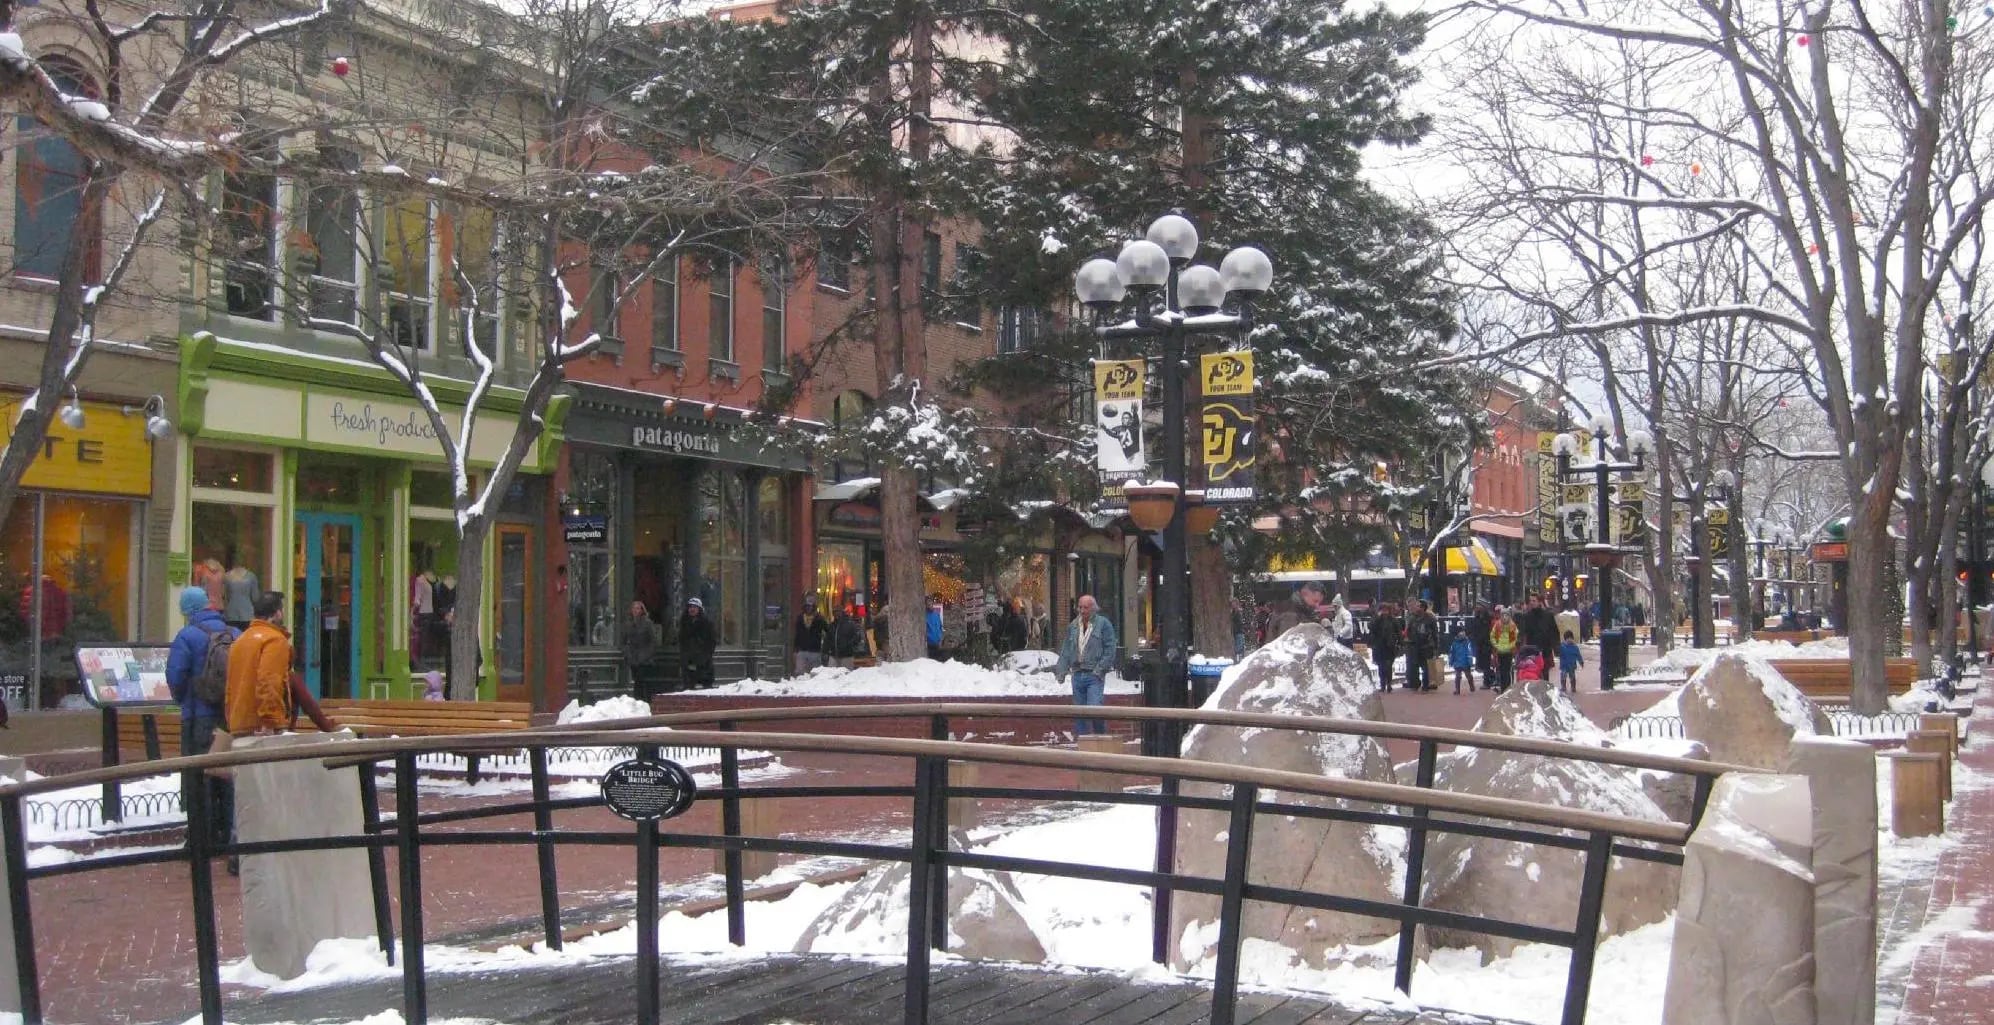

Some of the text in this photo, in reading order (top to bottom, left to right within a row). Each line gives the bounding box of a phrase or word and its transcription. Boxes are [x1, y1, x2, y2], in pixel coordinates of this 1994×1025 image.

[331, 402, 438, 444] fresh produce
[632, 426, 719, 453] patagonia
[1206, 487, 1253, 499] COLORADO
[567, 530, 602, 540] patagonia
[4, 675, 25, 684] store
